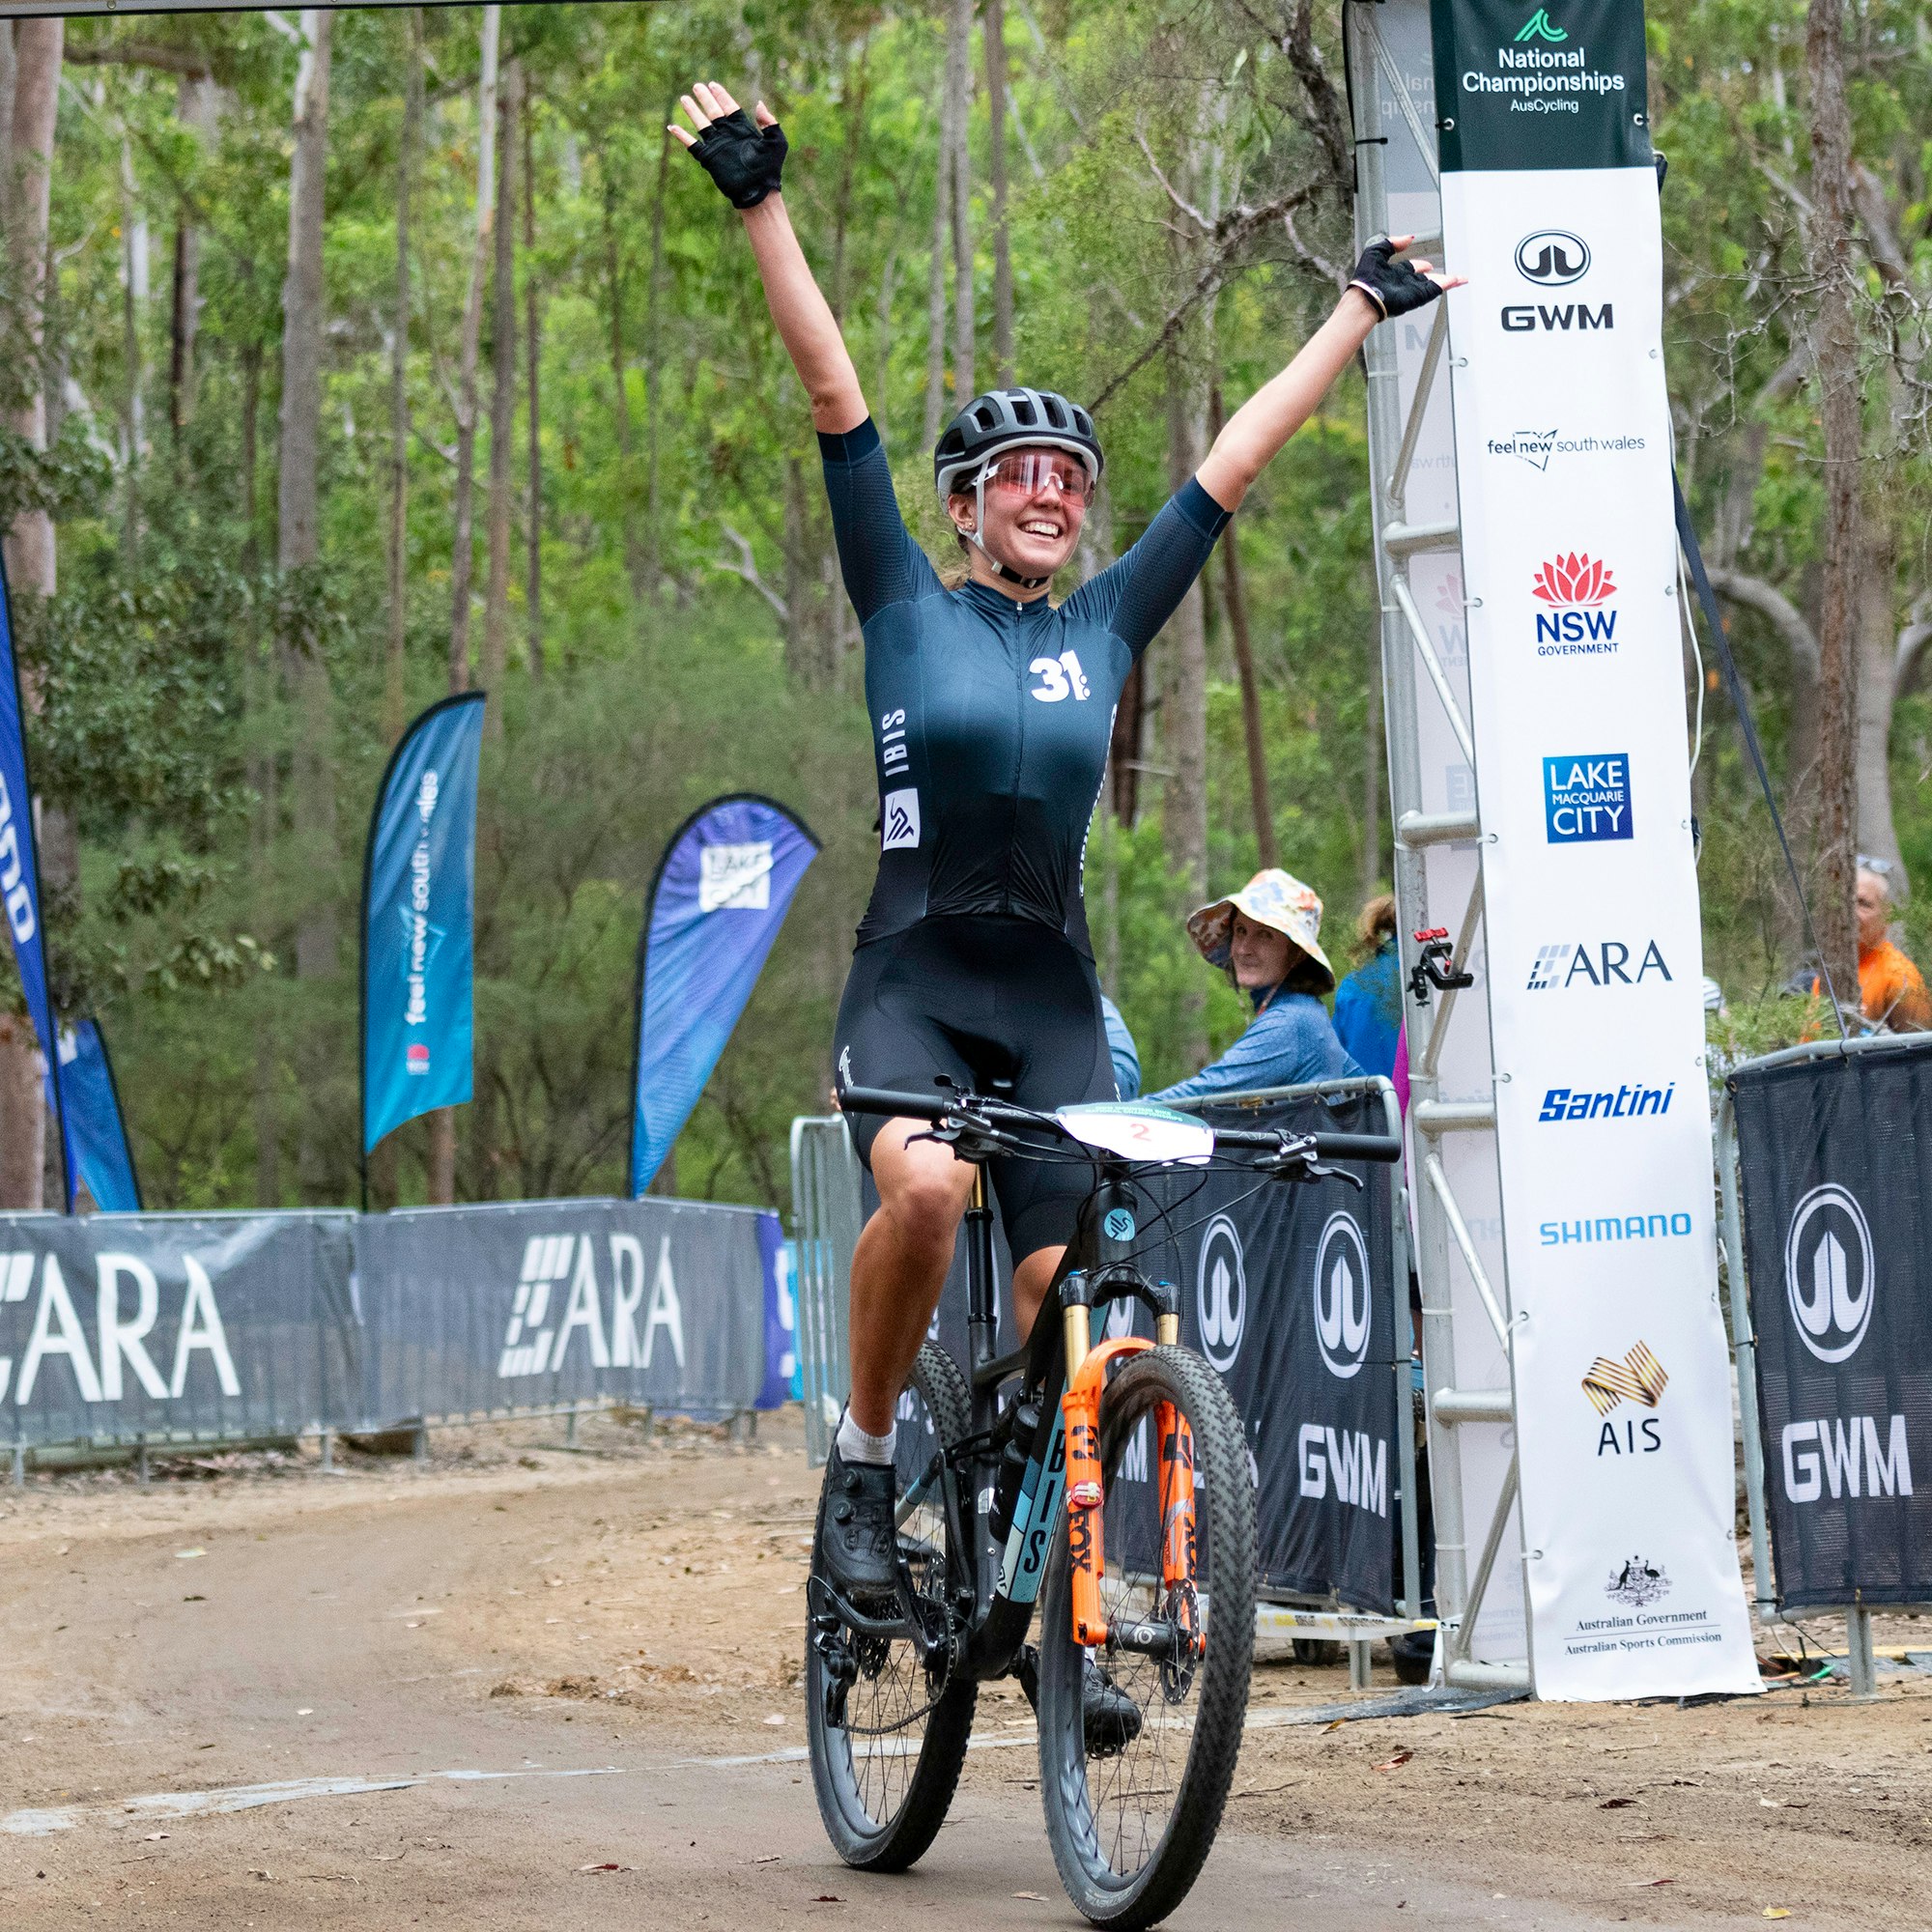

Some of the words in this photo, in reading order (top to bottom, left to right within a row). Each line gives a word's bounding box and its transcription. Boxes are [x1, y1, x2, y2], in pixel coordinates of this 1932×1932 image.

[1498, 47, 1585, 69] National
[1463, 71, 1625, 96] Championships
[1511, 99, 1579, 114] AusCycling
[1501, 303, 1614, 331] GWM
[1488, 439, 1516, 454] feel
[1520, 440, 1553, 453] new
[1557, 437, 1599, 453] south
[1601, 435, 1646, 451] wales
[1536, 611, 1617, 643] NSW
[1538, 642, 1619, 657] GOVERNMENT
[882, 708, 910, 778] IBIS
[1550, 760, 1624, 791] LAKE
[414, 769, 440, 837] ales
[1552, 789, 1625, 806] MACQUARIE
[1552, 805, 1625, 836] CITY
[1564, 939, 1674, 988] ARA
[1539, 1082, 1676, 1122] Santini
[1129, 1123, 1151, 1142] 2
[1539, 1213, 1692, 1246] SHIMANO
[551, 1231, 685, 1373] ARA
[14, 1252, 242, 1406] ARA
[1598, 1418, 1662, 1456] AIS
[1298, 1423, 1387, 1519] GWM
[1781, 1414, 1914, 1504] GWM
[1068, 1510, 1093, 1575] FOX
[1576, 1615, 1634, 1632] Australian
[1636, 1608, 1708, 1626] Government
[1564, 1641, 1618, 1656] Australian
[1620, 1639, 1655, 1653] Sports
[1658, 1632, 1722, 1648] Commission
